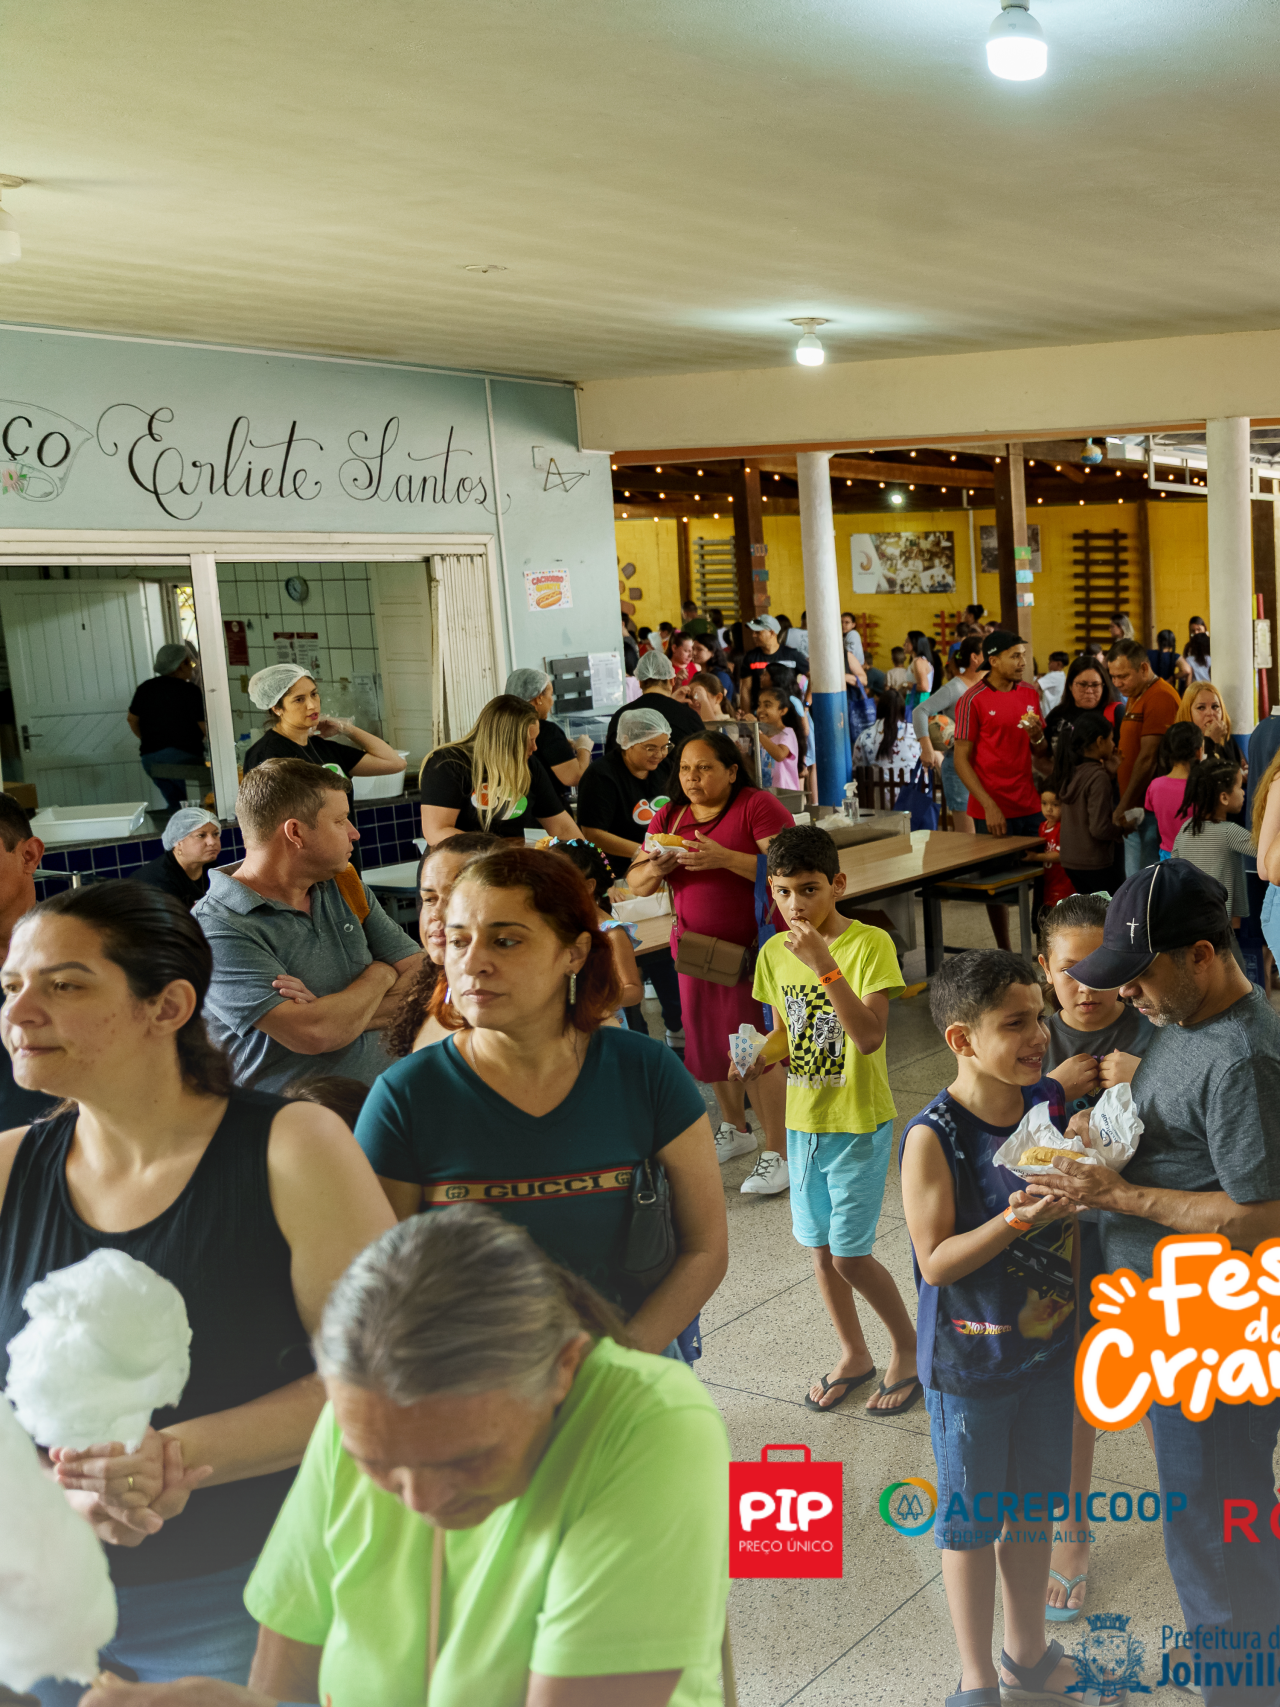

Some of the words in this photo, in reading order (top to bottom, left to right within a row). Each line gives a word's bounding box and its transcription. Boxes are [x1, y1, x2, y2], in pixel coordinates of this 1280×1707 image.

[97, 404, 324, 520] Erliete
[339, 417, 512, 515] Santos
[484, 1175, 604, 1199] GUCCI
